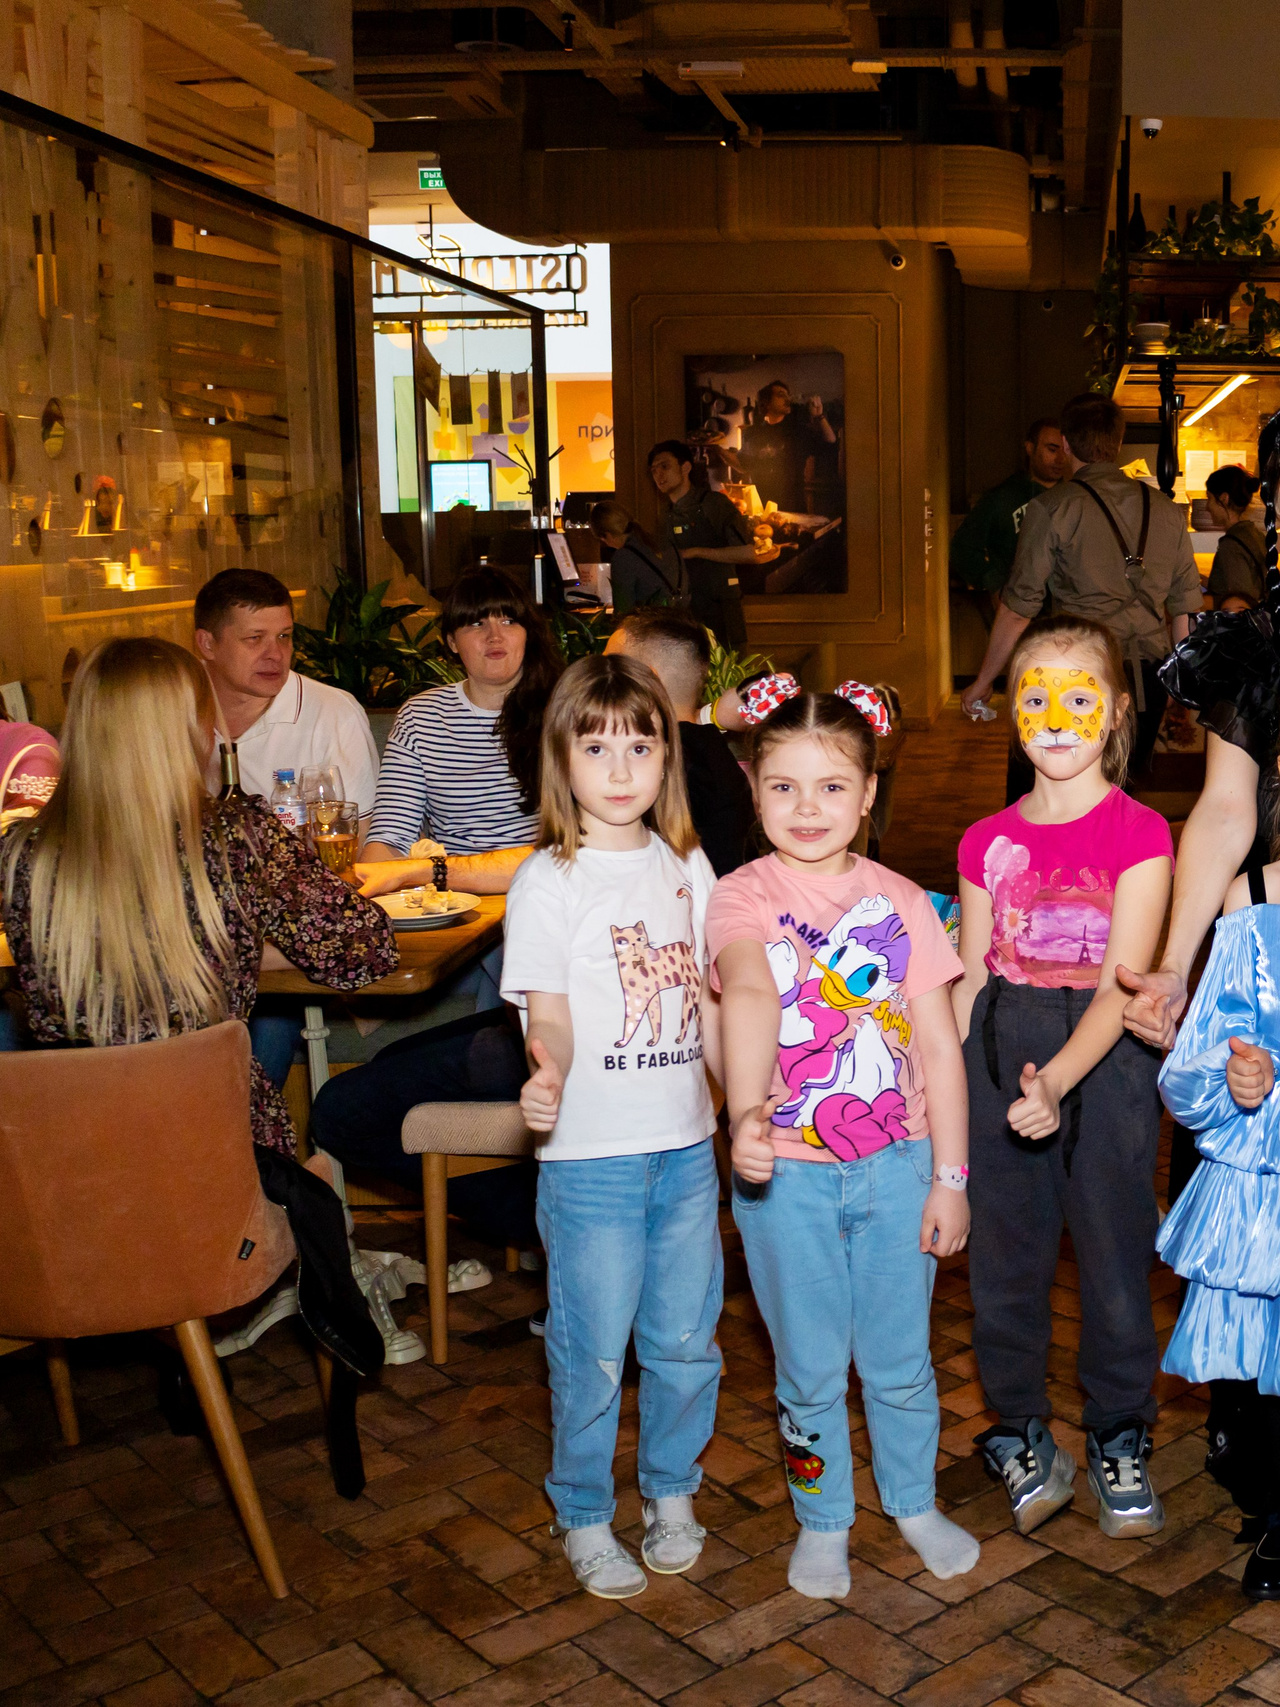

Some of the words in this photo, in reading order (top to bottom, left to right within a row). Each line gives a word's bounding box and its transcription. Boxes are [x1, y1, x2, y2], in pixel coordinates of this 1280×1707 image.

[423, 171, 442, 179] ВЫХ
[578, 425, 614, 442] при
[873, 1000, 913, 1048] JUMP!
[604, 1054, 627, 1070] BE
[637, 1044, 704, 1070] FABULOUS
